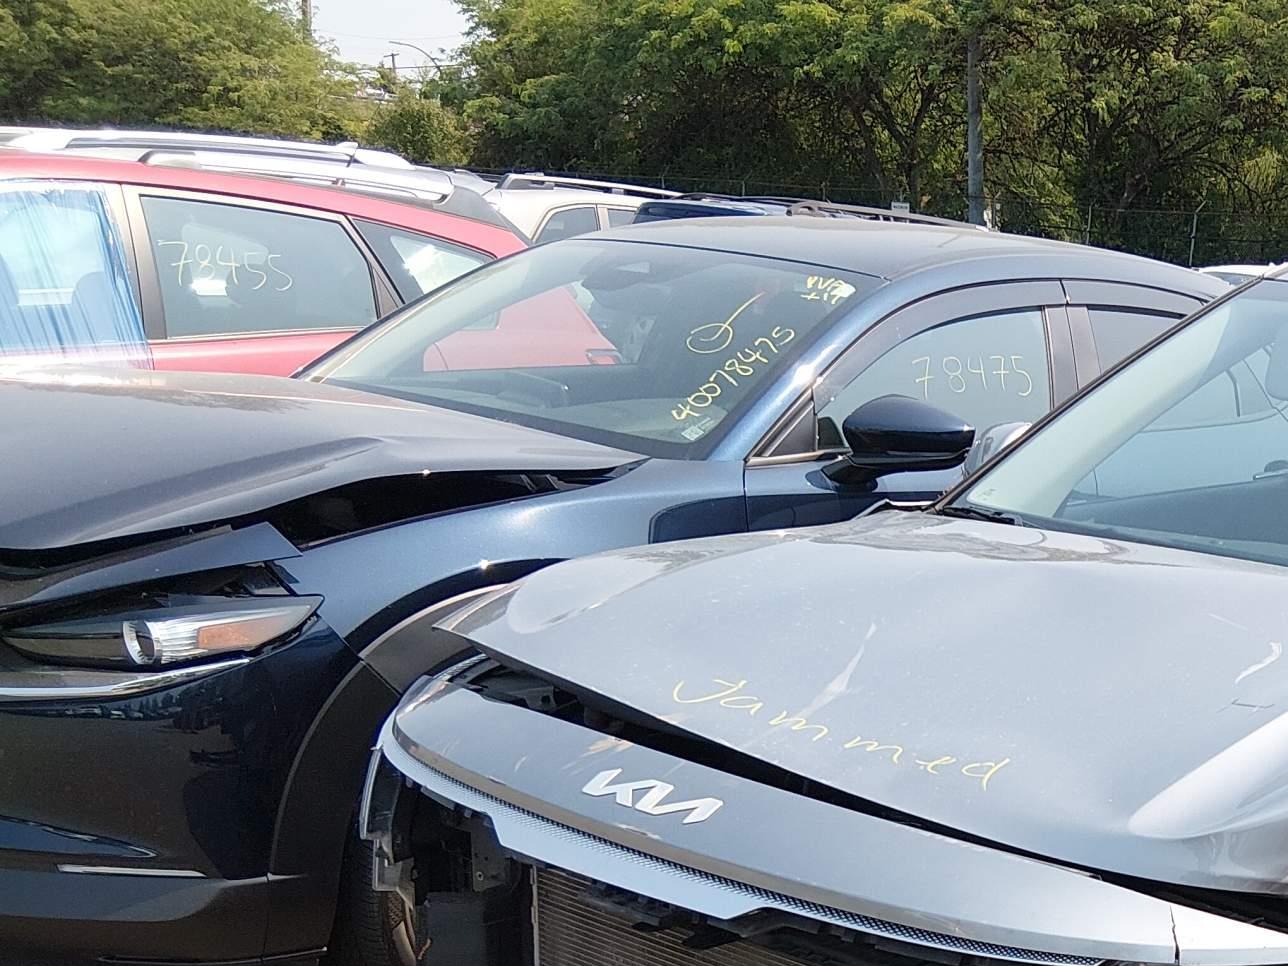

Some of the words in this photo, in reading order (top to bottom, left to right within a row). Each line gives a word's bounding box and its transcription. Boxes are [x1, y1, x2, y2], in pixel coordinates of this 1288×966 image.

[157, 240, 294, 291] 78455
[671, 326, 796, 421] 40078475
[912, 352, 1032, 400] 78475
[673, 679, 1011, 792] Jammed
